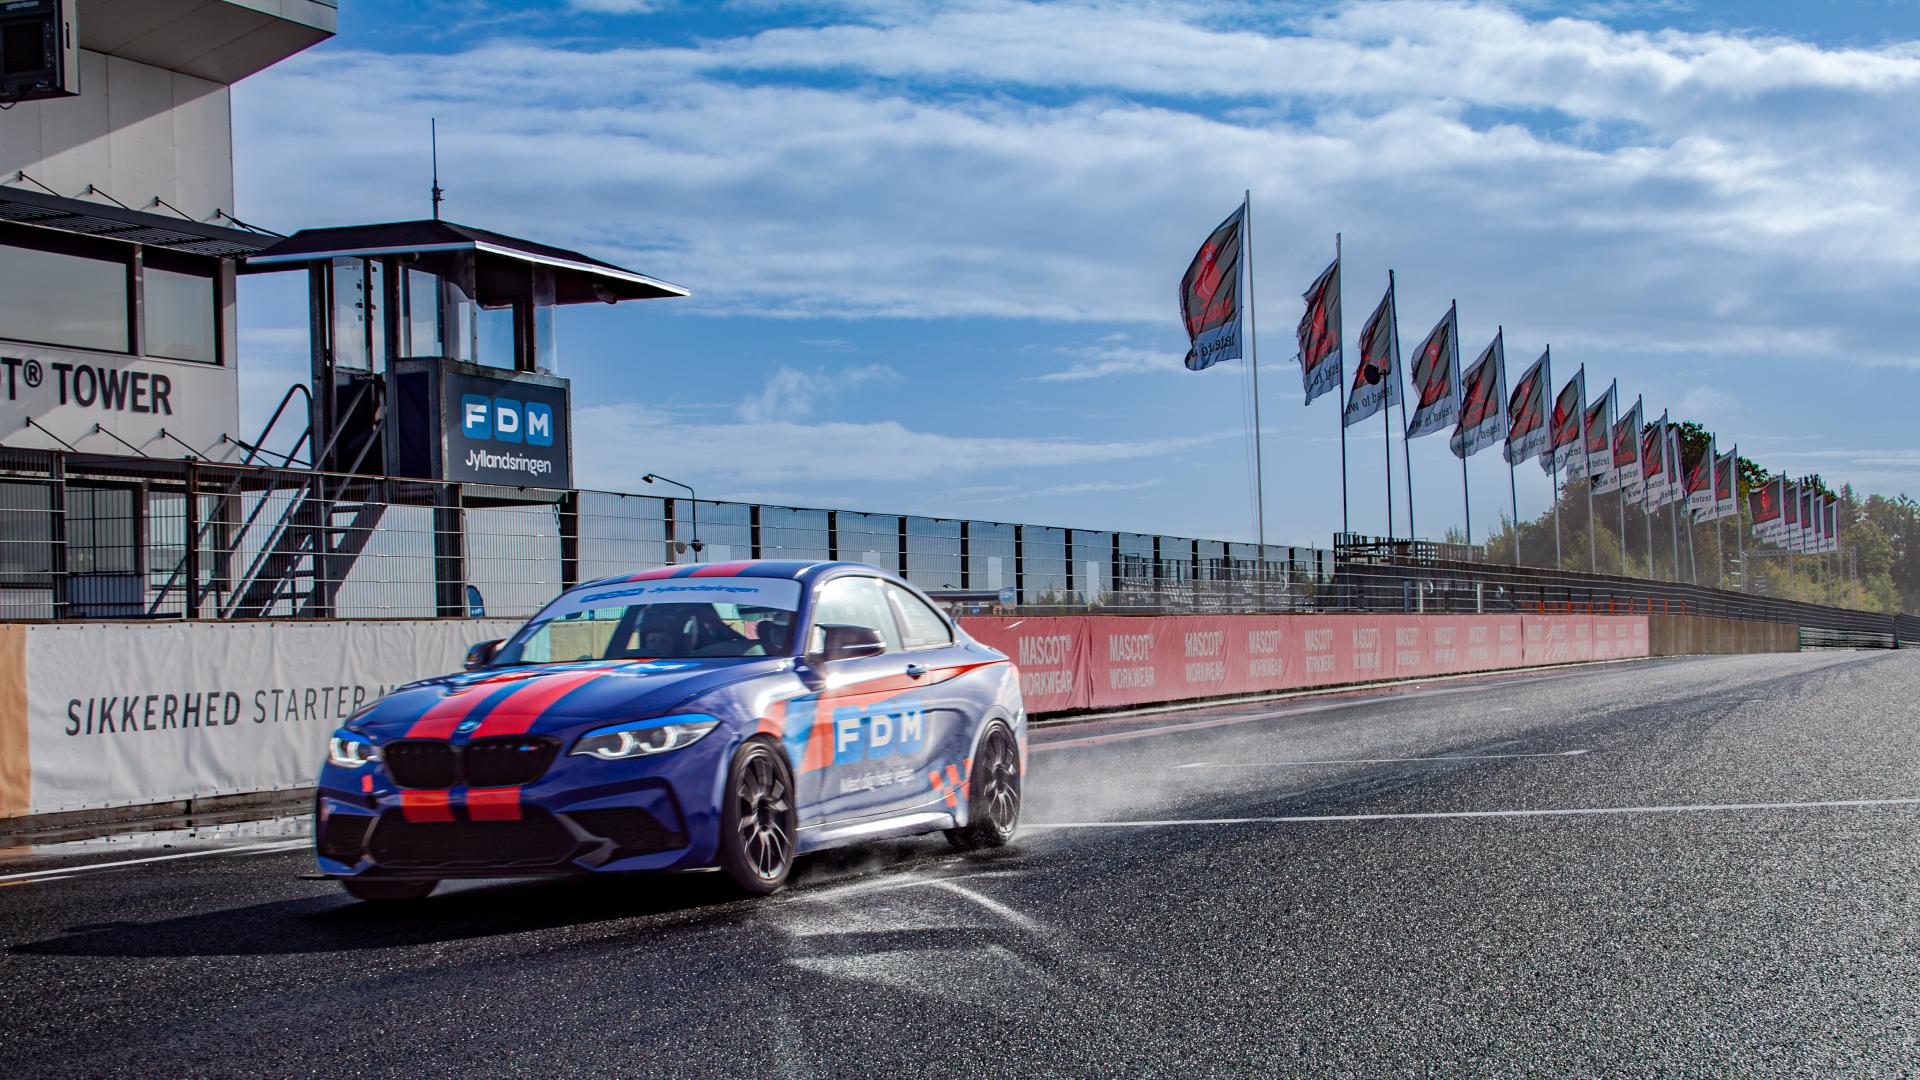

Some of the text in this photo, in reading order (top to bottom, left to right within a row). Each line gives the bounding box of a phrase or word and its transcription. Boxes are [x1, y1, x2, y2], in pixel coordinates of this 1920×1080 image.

[0, 357, 173, 415] T® TOWER
[466, 403, 549, 437] FDM
[465, 449, 552, 477] Jyllandsringen
[1109, 633, 1154, 662] MASCOT®
[1110, 666, 1156, 689] WORKWEAR
[65, 685, 366, 736] SIKKERHED STARTER
[837, 710, 923, 753] FDM
